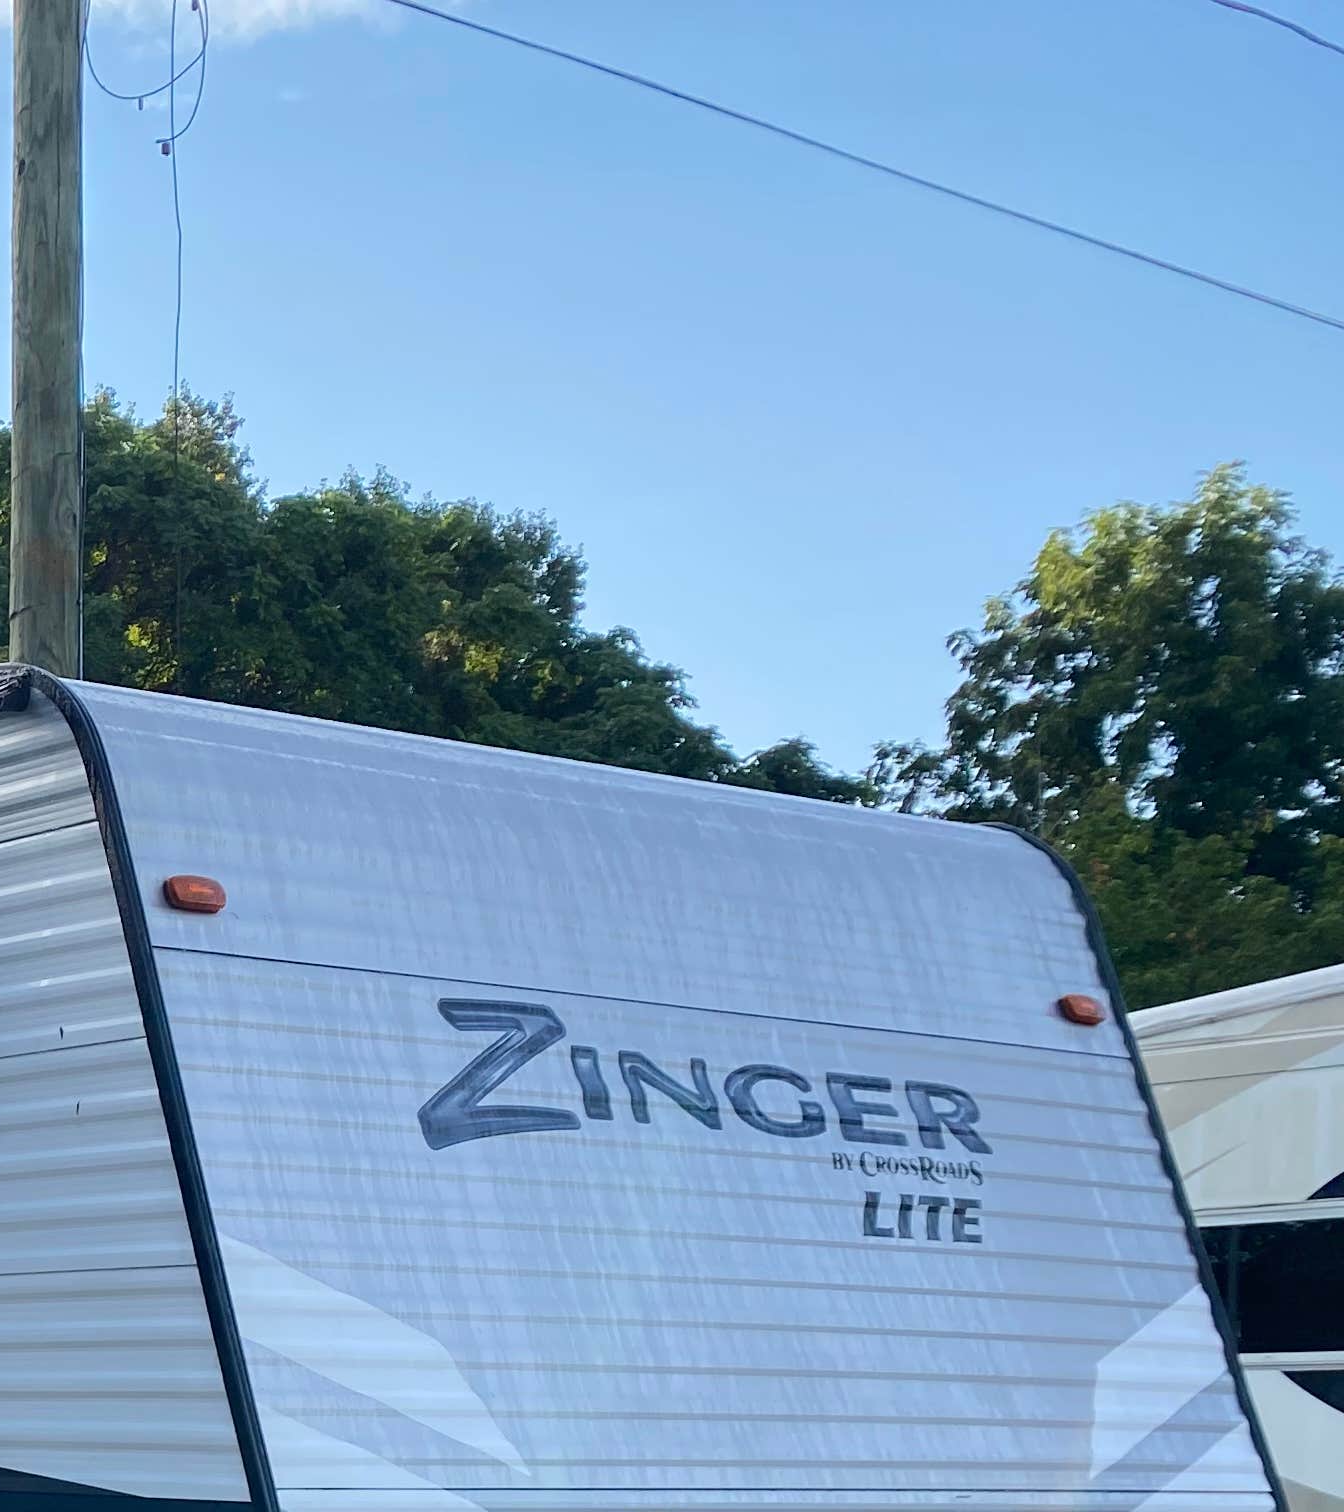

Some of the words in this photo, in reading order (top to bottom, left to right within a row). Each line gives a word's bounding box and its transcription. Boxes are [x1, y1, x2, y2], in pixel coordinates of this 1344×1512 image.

[417, 998, 993, 1155] ZINGER
[832, 1152, 854, 1171] BY
[864, 1191, 983, 1243] LITE
